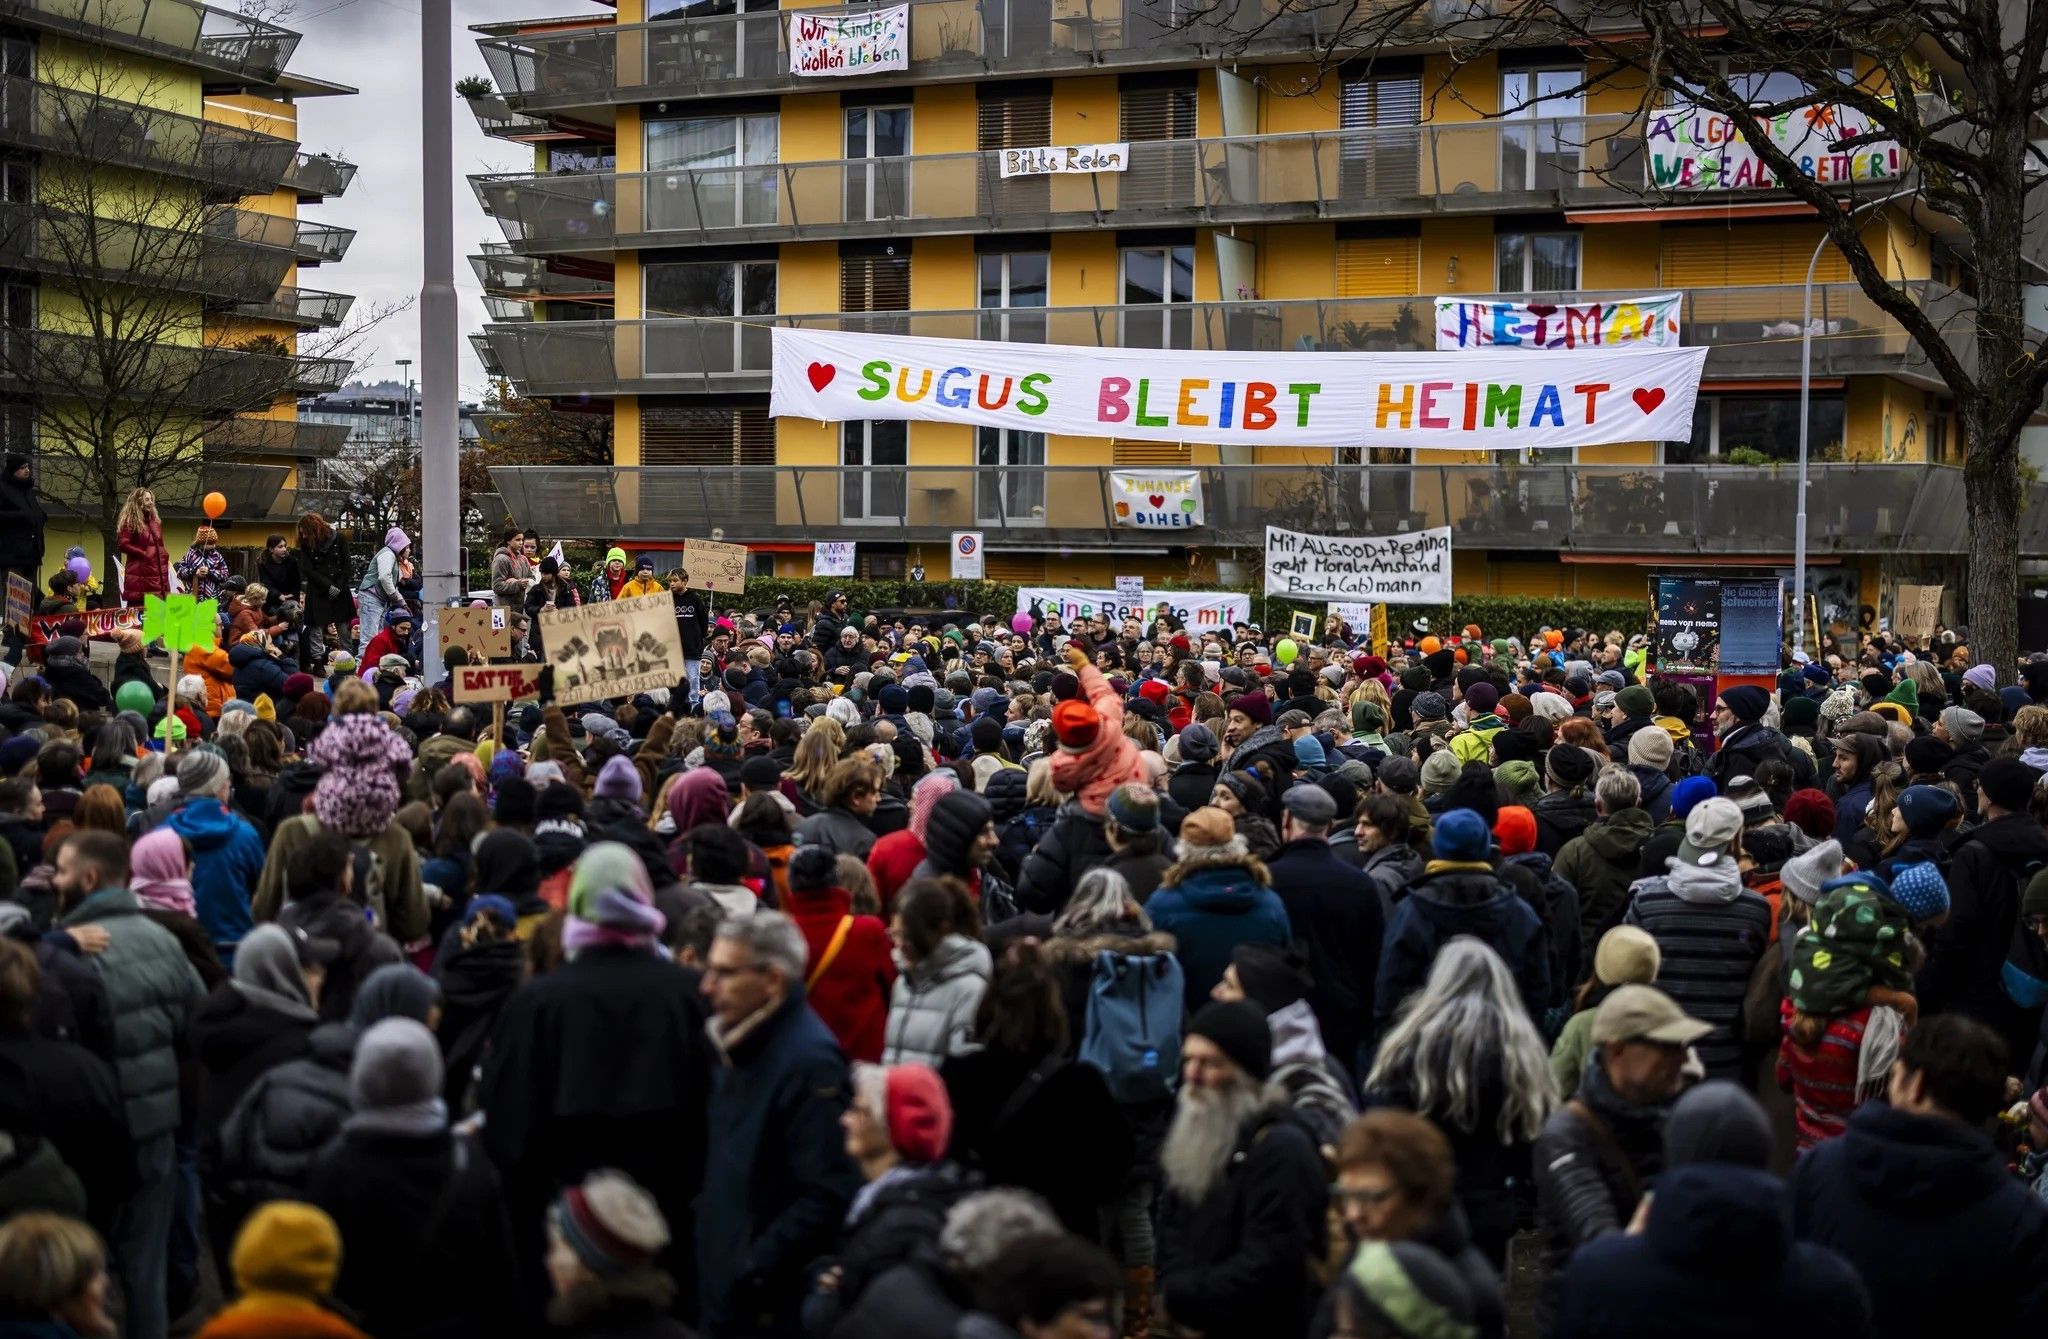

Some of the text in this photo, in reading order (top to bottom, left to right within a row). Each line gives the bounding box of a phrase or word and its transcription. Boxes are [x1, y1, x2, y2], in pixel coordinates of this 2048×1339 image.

[800, 13, 891, 40] Wir Kinder
[801, 48, 844, 71] wollen
[856, 360, 1611, 431] SUGUS BLEIBT HEIMAT
[1136, 511, 1192, 526] DIHEI
[1270, 532, 1297, 552] Mit
[1273, 556, 1308, 575] geht
[1197, 605, 1235, 625] mit
[463, 671, 496, 690] EAT
